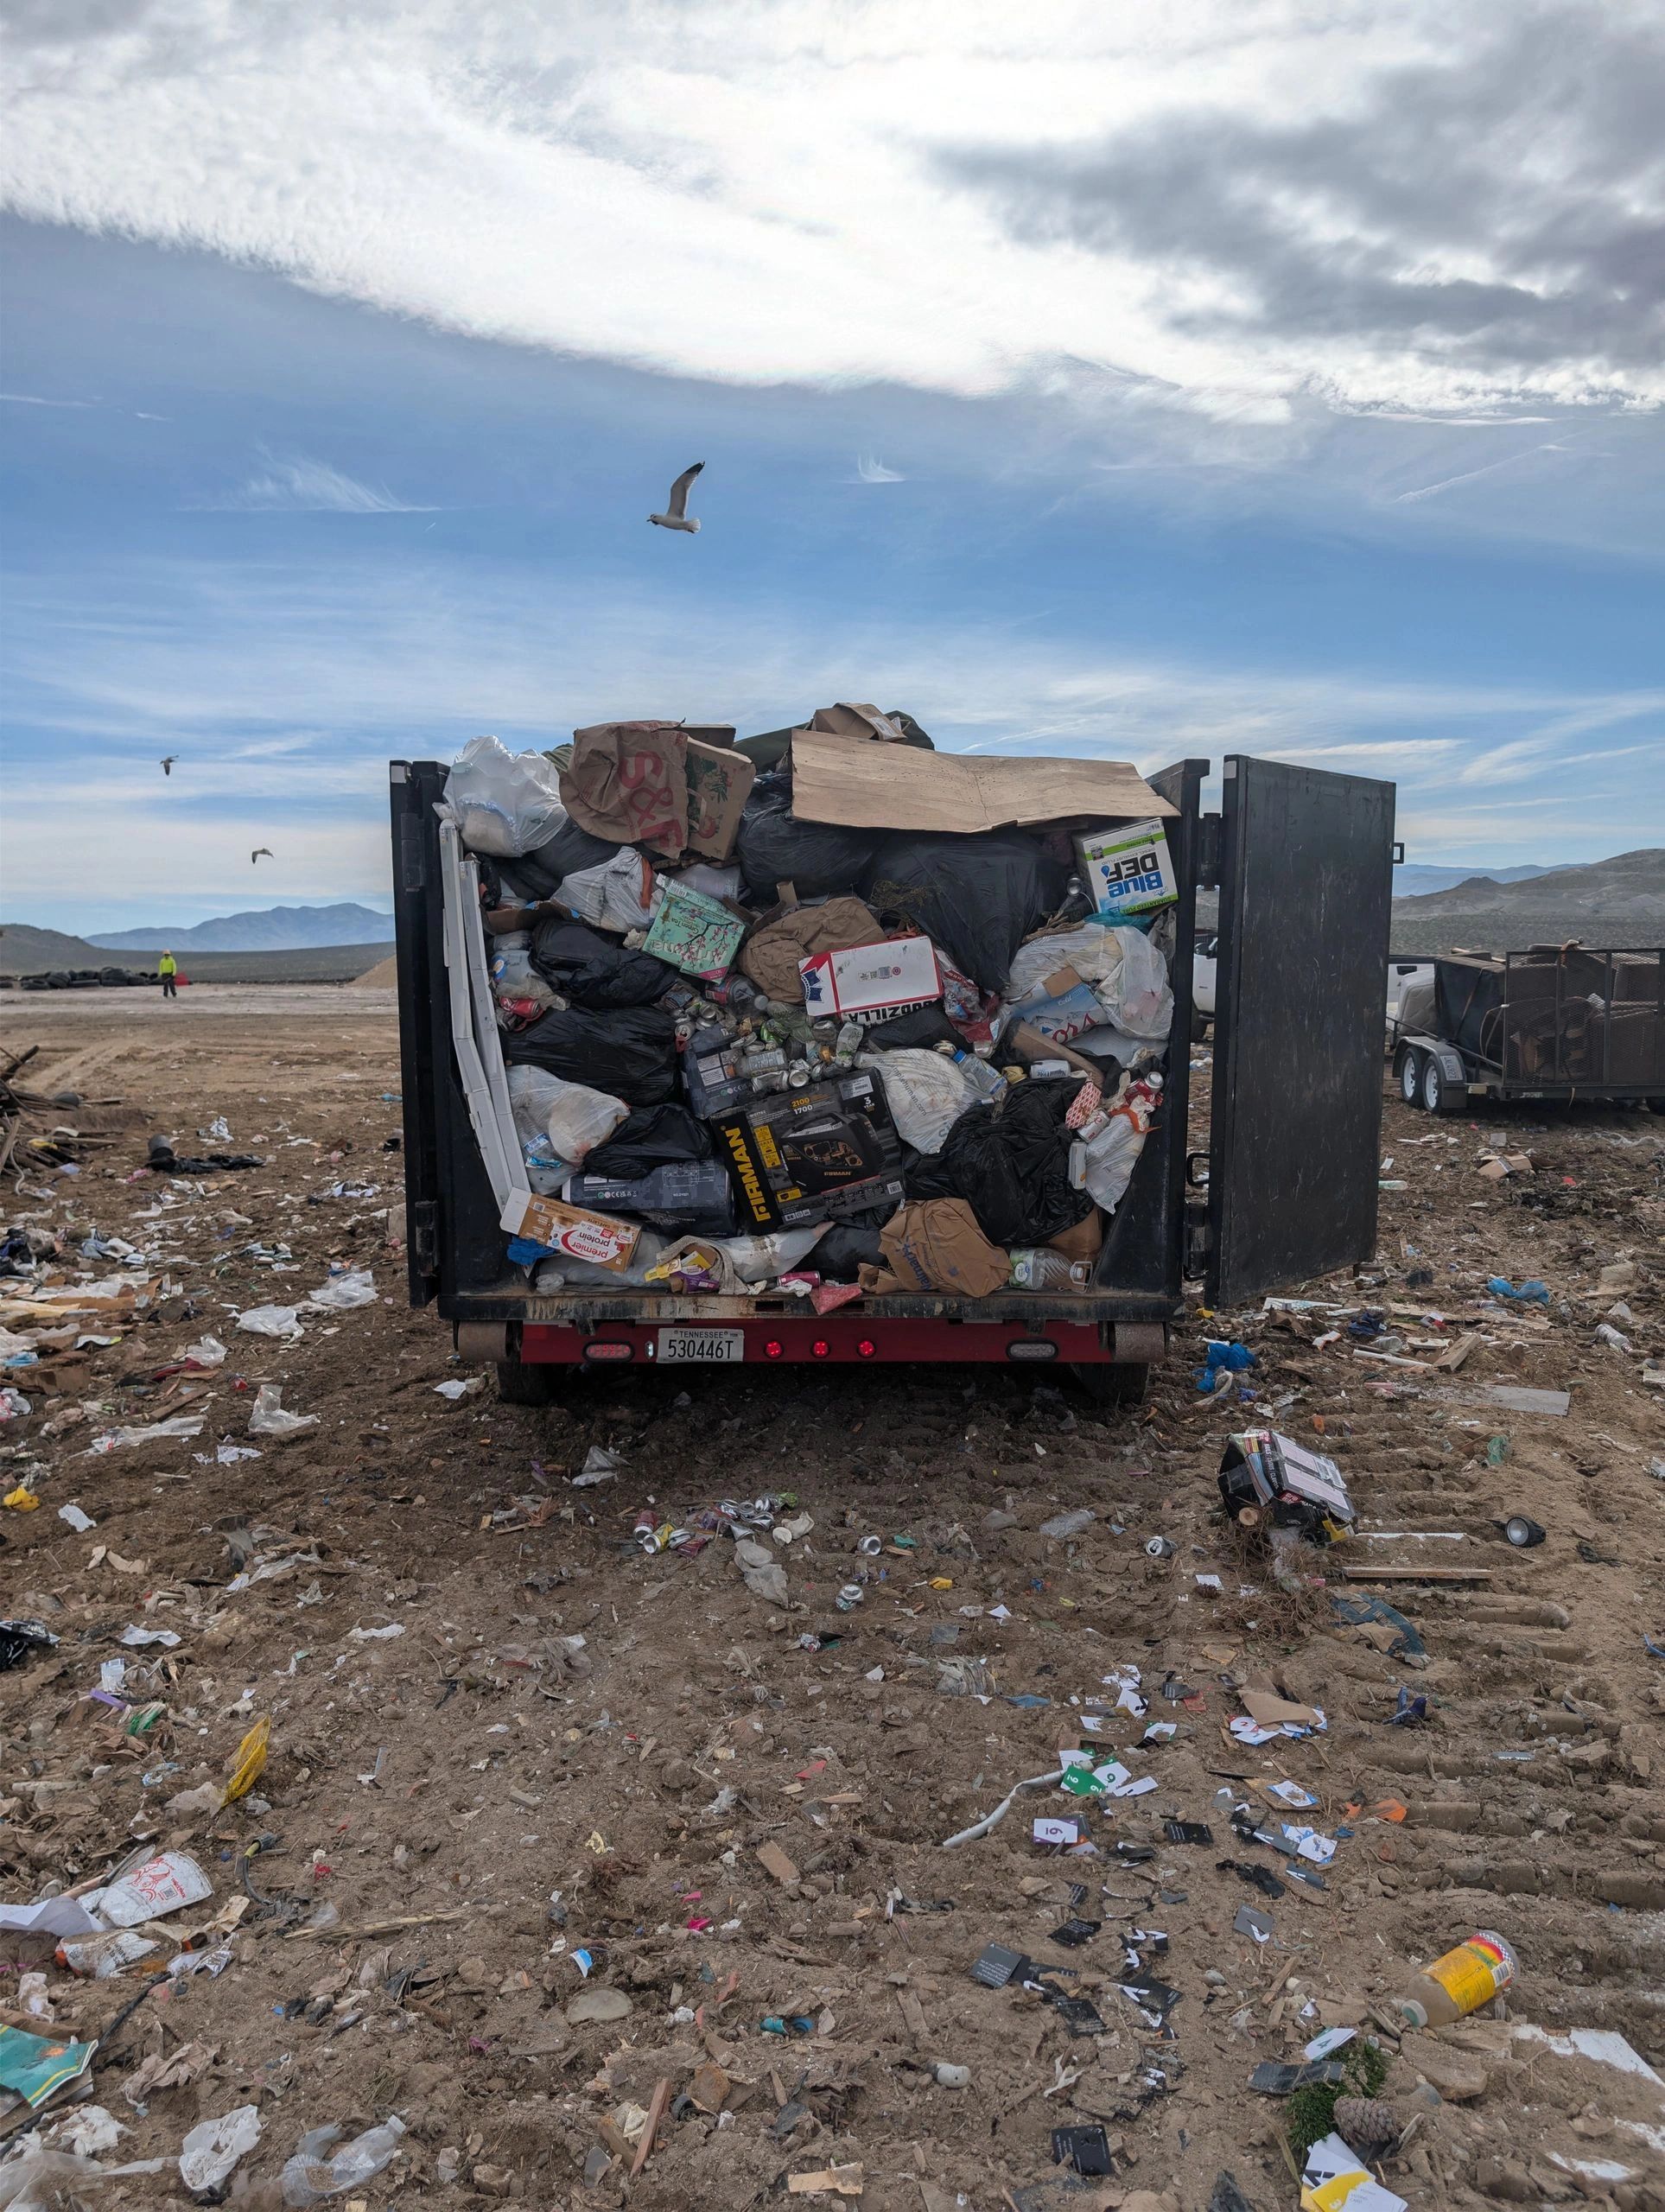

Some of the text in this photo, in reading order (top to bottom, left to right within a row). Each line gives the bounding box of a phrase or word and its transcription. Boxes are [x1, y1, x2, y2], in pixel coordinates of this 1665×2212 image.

[1106, 852, 1159, 885] DEF
[1107, 871, 1163, 899] Blue
[671, 918, 683, 927] Tea
[791, 1097, 810, 1107] 2100
[864, 1096, 872, 1105] 3
[793, 1104, 813, 1115] 1700
[726, 1127, 772, 1222] FIRMAN
[579, 1231, 611, 1247] protein
[571, 1241, 609, 1259] premier
[668, 1339, 734, 1359] 530446T
